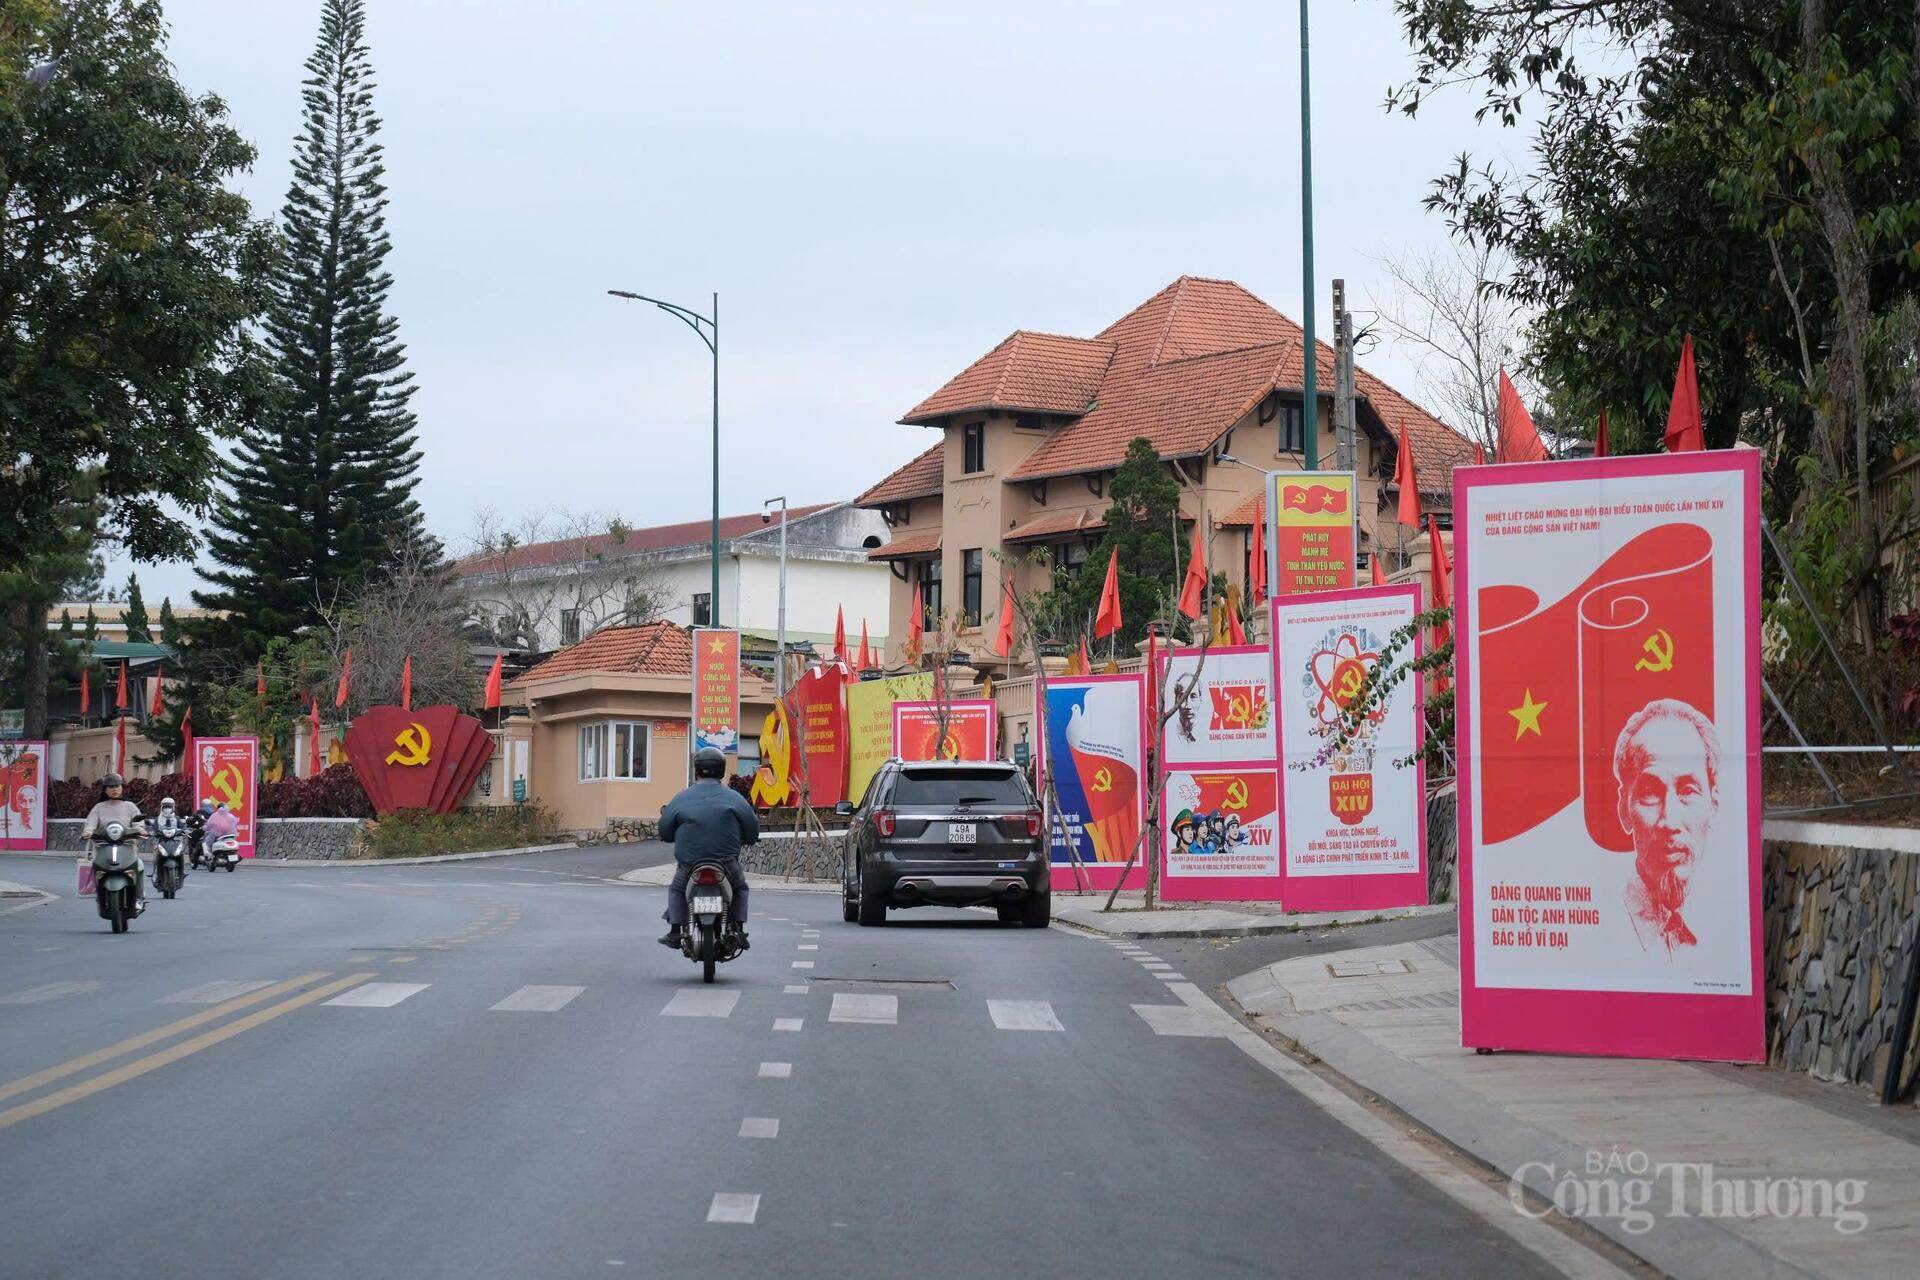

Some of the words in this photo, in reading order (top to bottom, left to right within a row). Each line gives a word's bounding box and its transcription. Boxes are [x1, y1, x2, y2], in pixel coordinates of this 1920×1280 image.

[1485, 510, 1506, 522] NHIỆT
[1508, 509, 1522, 521] LIỆT
[1524, 508, 1543, 520] CHÀO
[1546, 506, 1568, 518] MỪNG
[1570, 507, 1582, 519] ĐẠI
[1584, 505, 1597, 518] HỘI
[1599, 505, 1612, 517] ĐẠI
[1614, 502, 1630, 515] BIỂU
[1633, 502, 1653, 514] TOÀN
[1655, 501, 1675, 513] QUỐC
[1677, 500, 1692, 511] LẦN
[1694, 498, 1710, 510] THỨ
[1711, 500, 1724, 510] XIV
[1485, 524, 1499, 536] CỦA
[1502, 522, 1521, 535] ĐẢNG
[1524, 522, 1544, 535] CỘNG
[1546, 519, 1560, 533] SẢN
[1563, 520, 1578, 532] VIỆT
[1580, 521, 1600, 531] NAM!
[1332, 780, 1350, 793] ĐẠI
[1352, 777, 1370, 792] HỘI
[1336, 795, 1369, 811] XIV
[955, 824, 970, 834] 49A
[1249, 829, 1272, 846] XIV
[950, 833, 976, 843] 208.66
[1295, 854, 1302, 863] LÀ
[1491, 881, 1521, 901] ĐẢNG
[1525, 886, 1562, 903] QUANG
[1565, 886, 1592, 902] VINH
[1492, 905, 1515, 924] DÂN
[1518, 904, 1539, 927] TỘC
[1542, 909, 1565, 925] ANH
[1568, 906, 1600, 925] HÙNG
[1492, 928, 1515, 946] BÁC
[1518, 926, 1533, 947] HỒ
[1536, 928, 1547, 947] VĨ
[1550, 931, 1569, 951] ĐẠI
